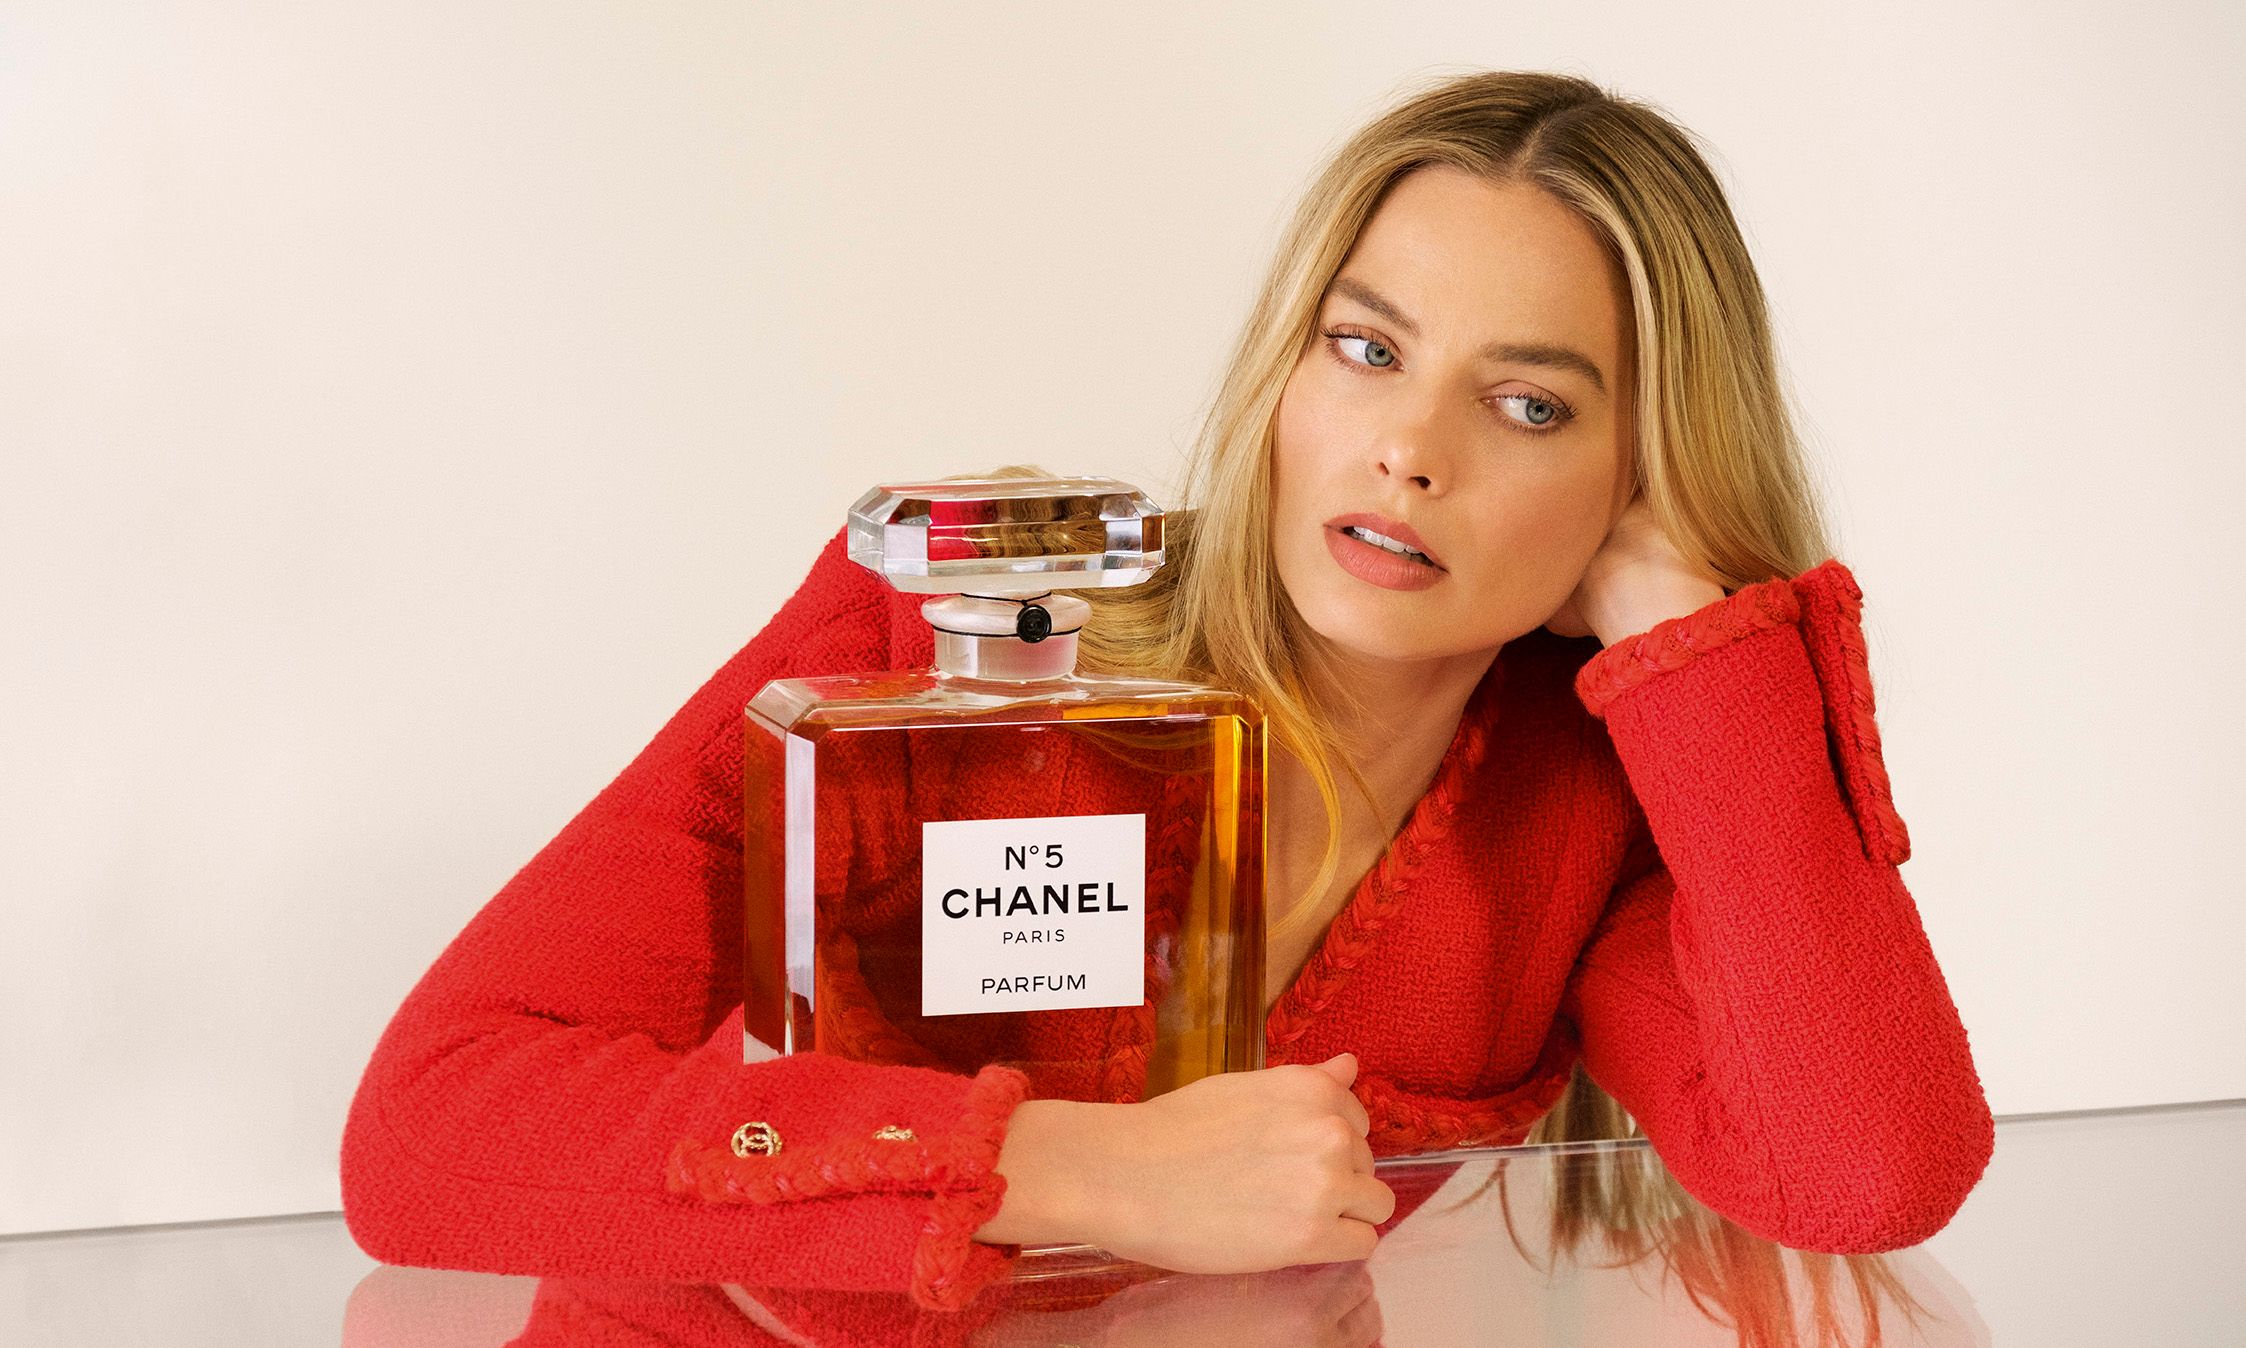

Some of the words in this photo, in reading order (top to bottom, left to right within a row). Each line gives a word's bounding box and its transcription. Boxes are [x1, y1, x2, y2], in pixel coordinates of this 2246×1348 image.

[941, 882, 1129, 919] CHANEL
[1002, 928, 1066, 945] PARIS
[981, 974, 1087, 995] PARFUM
